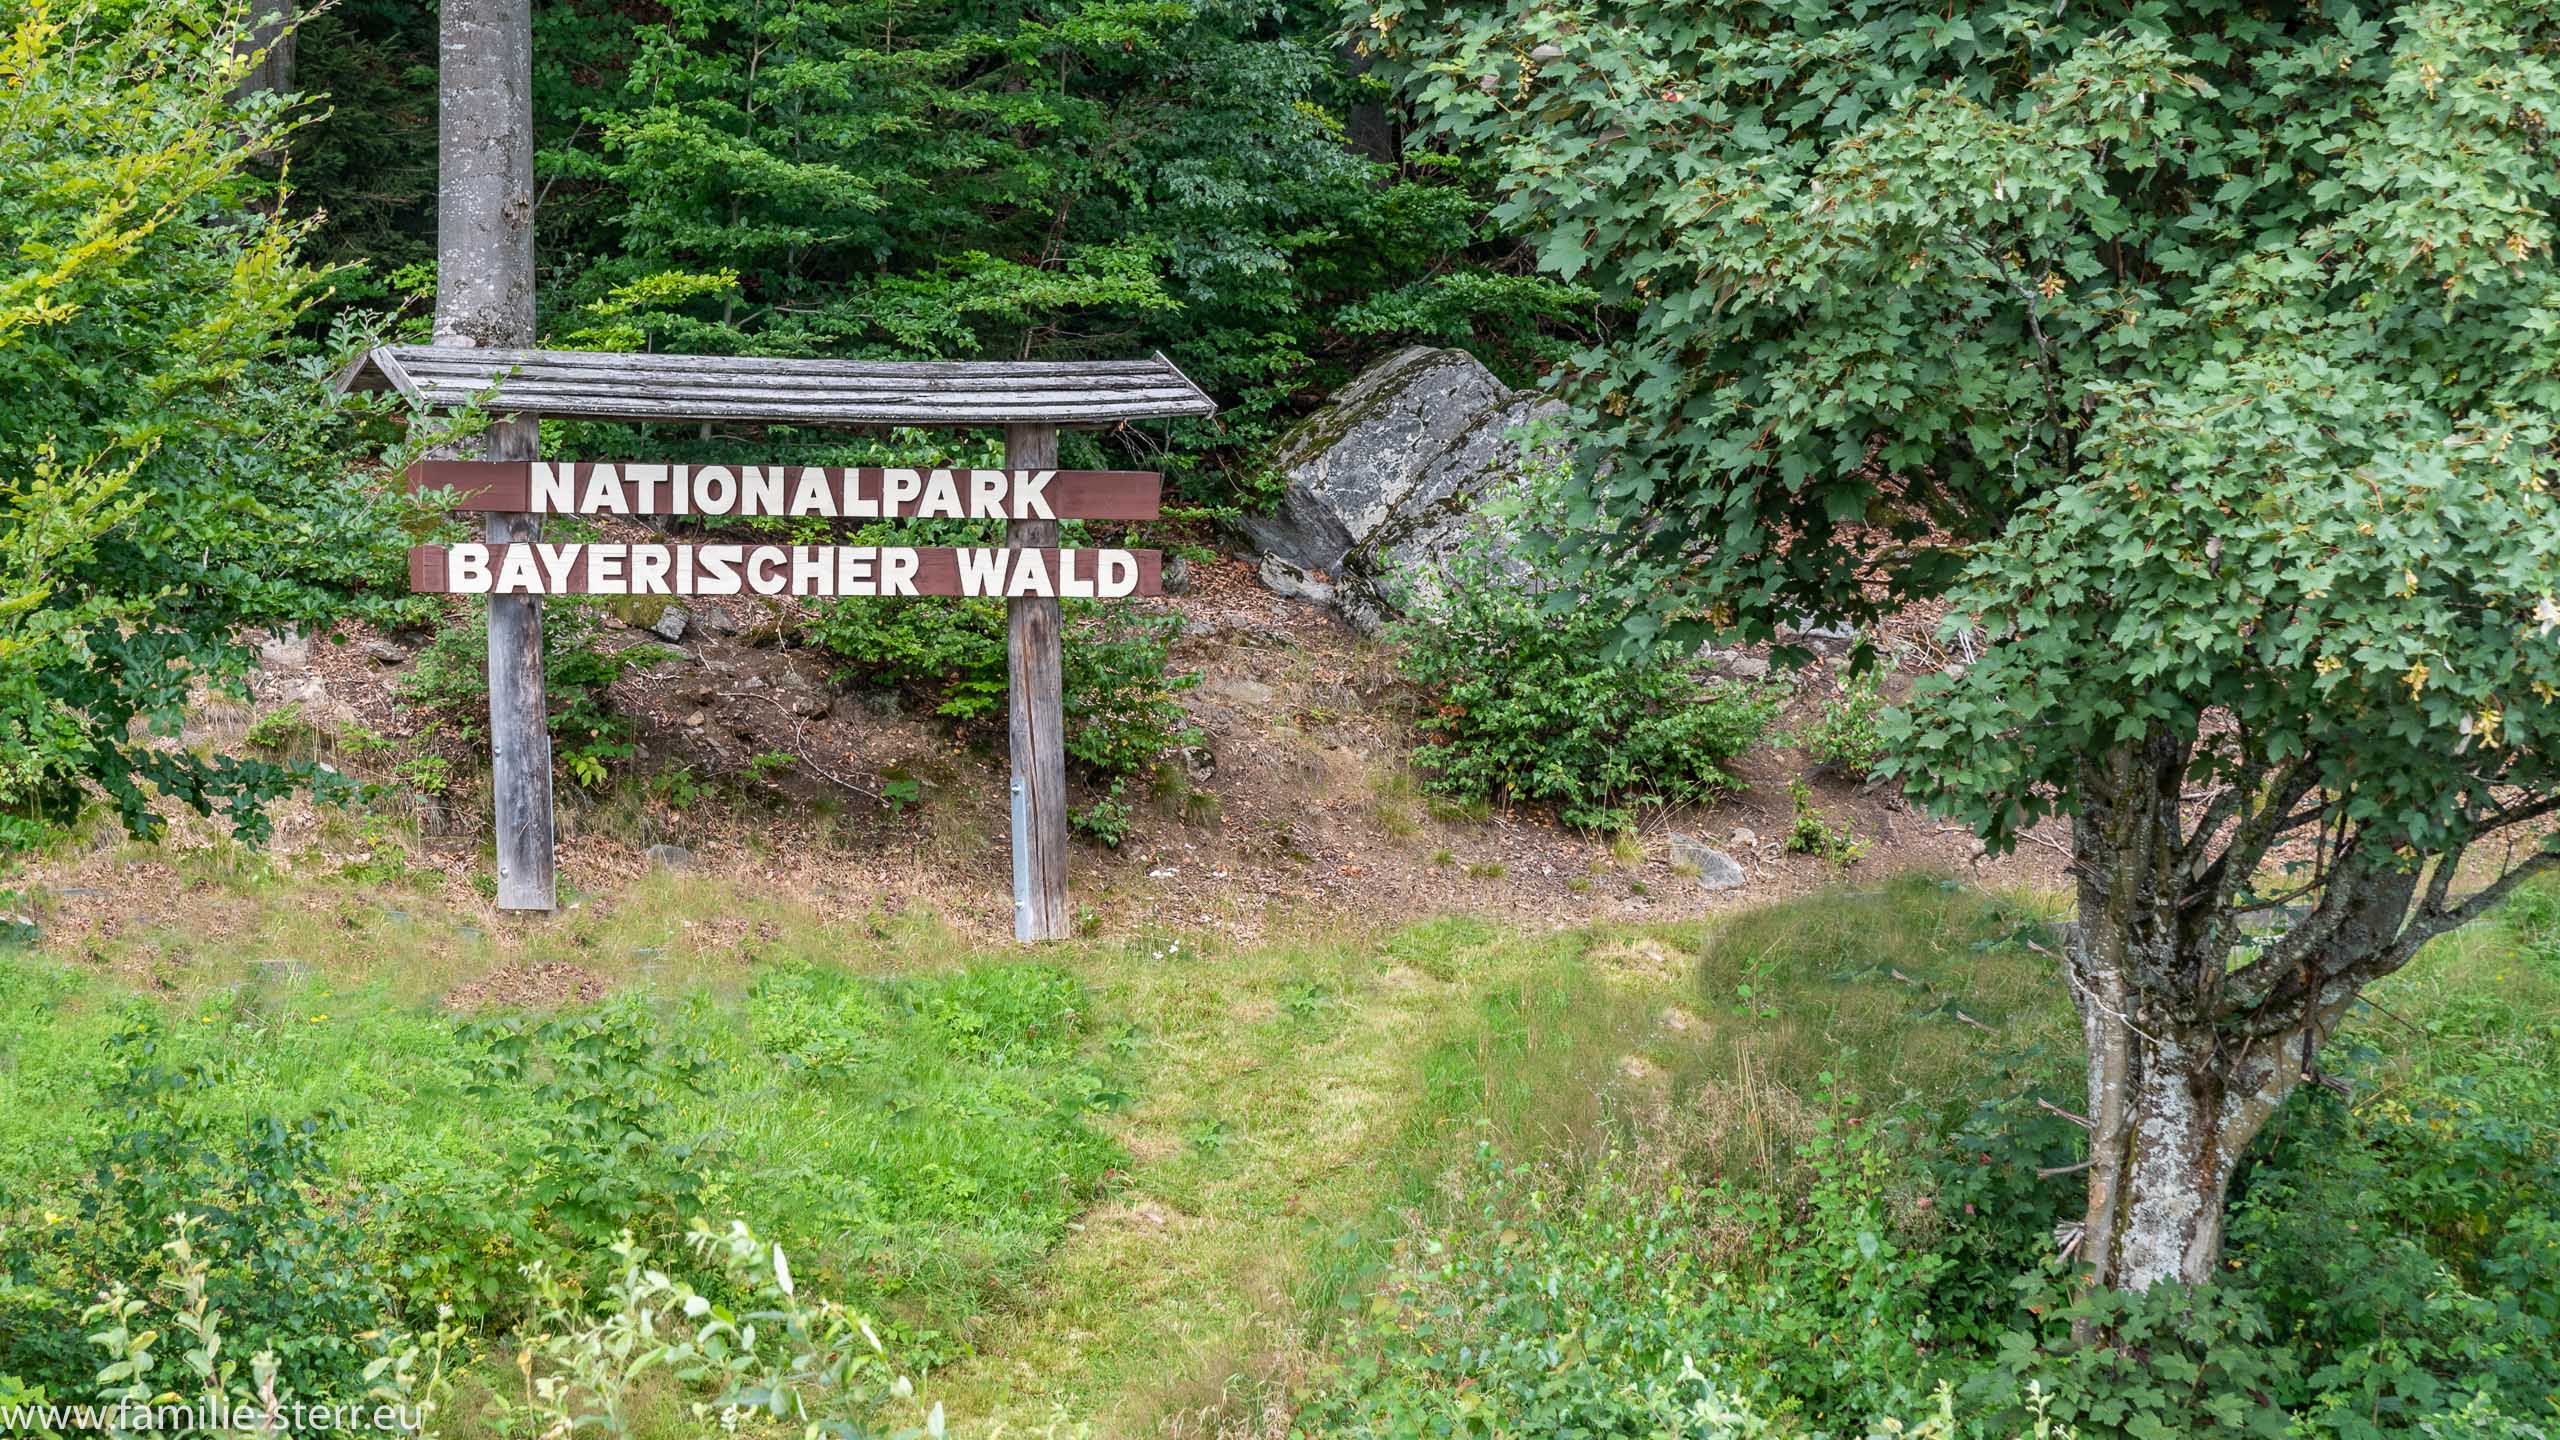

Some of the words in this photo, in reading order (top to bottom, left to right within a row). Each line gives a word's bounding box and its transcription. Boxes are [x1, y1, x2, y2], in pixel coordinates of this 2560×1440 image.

[530, 462, 1057, 519] NATIONALPARK
[448, 543, 920, 597] BAYERISCHER
[957, 547, 1139, 598] WALD
